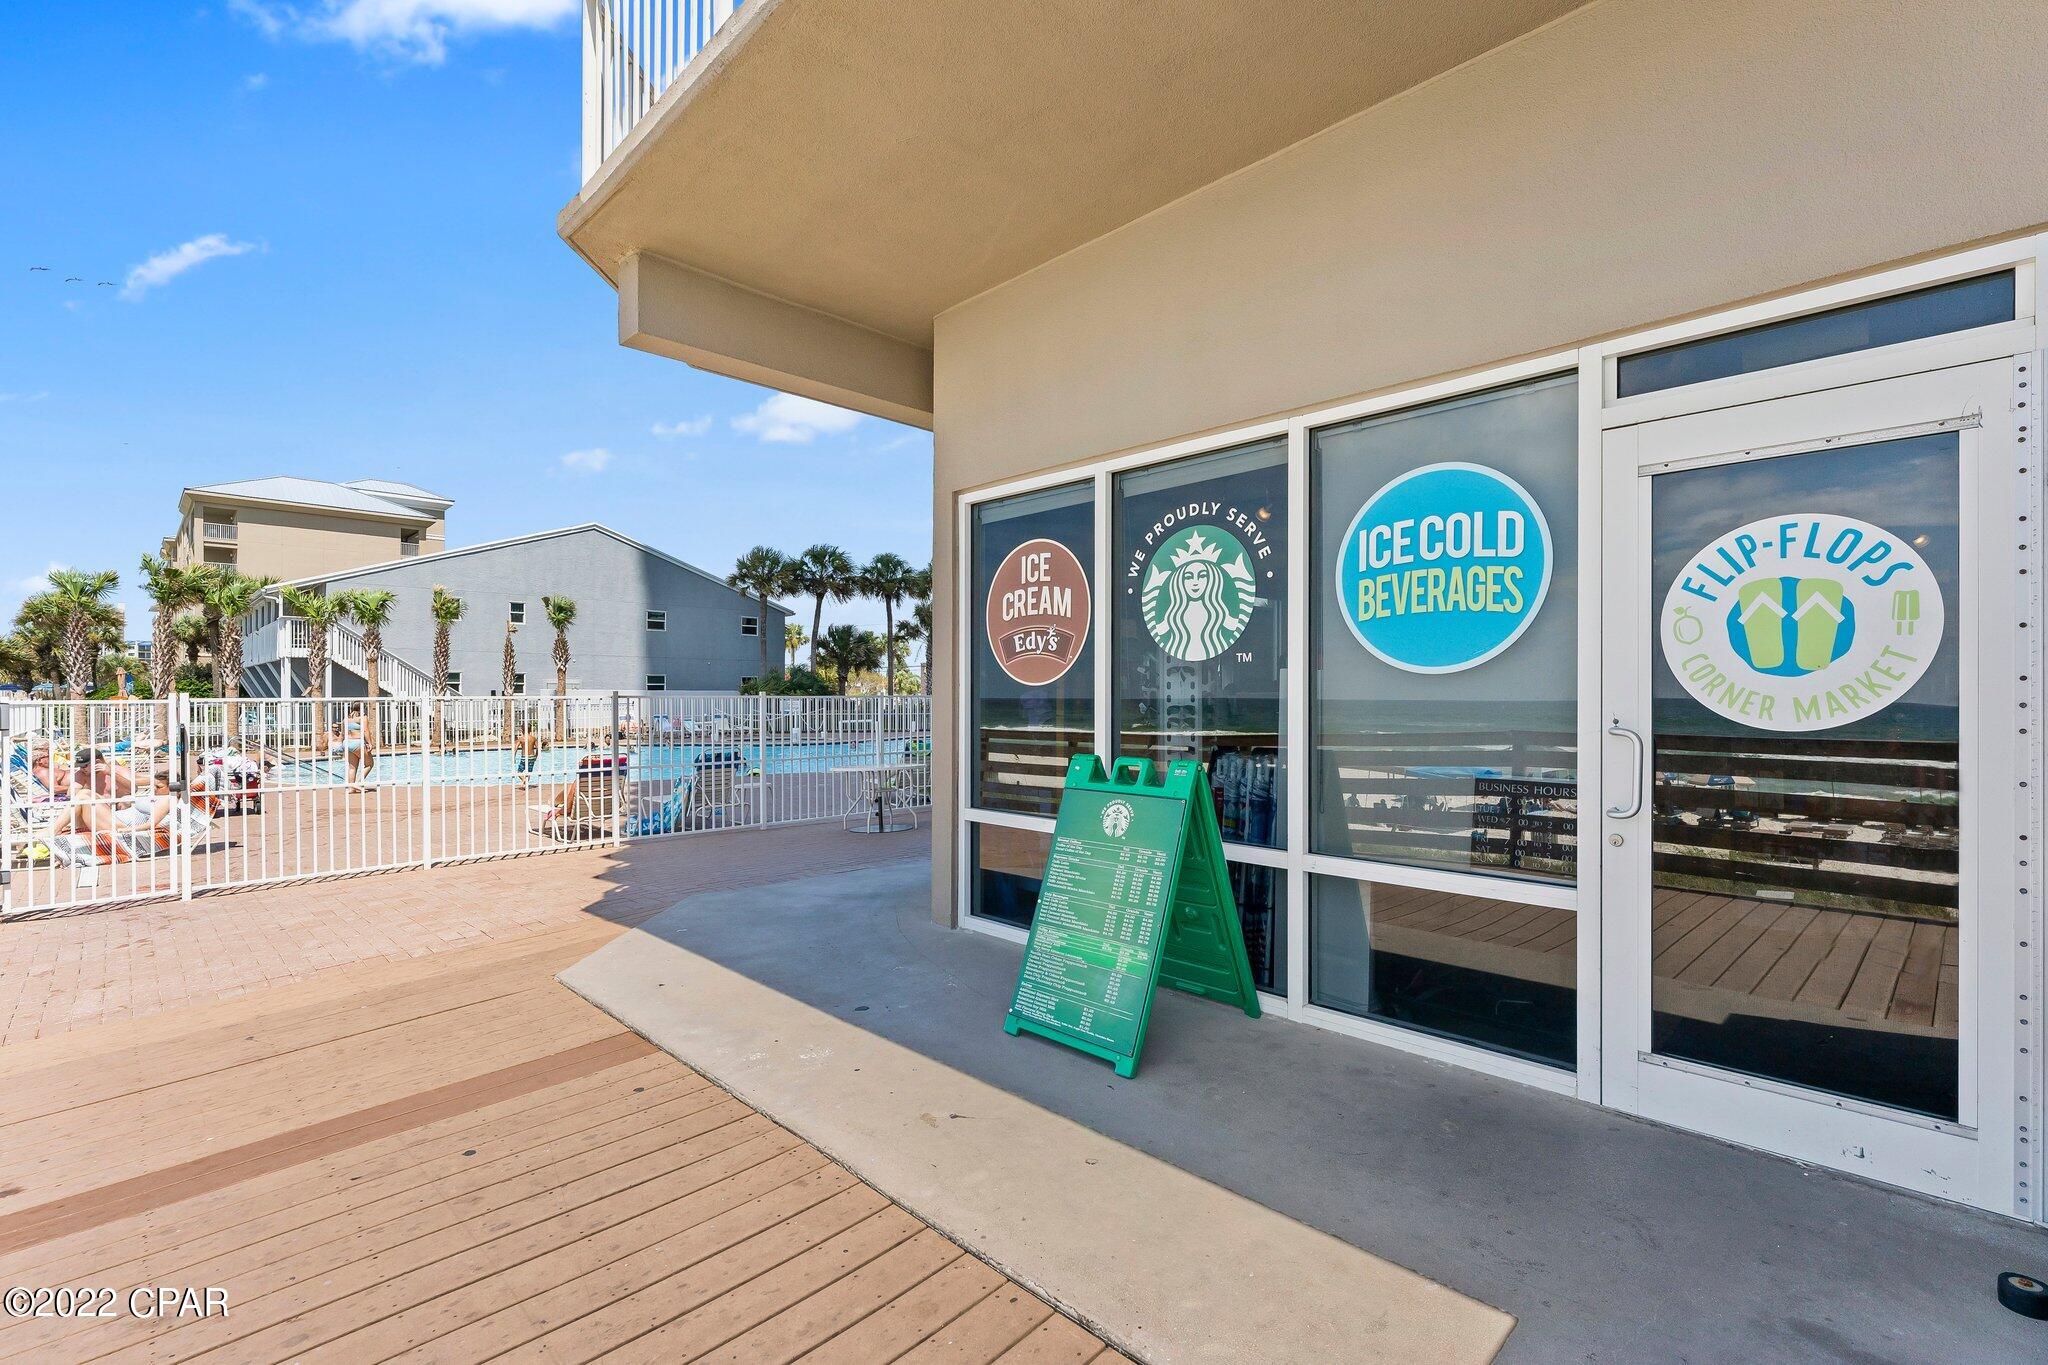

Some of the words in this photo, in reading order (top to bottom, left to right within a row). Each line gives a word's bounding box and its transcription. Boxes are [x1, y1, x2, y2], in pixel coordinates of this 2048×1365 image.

[1127, 549, 1147, 578] WE
[1144, 501, 1221, 546] PROUDLY
[1225, 506, 1272, 560] SERVE
[1358, 518, 1415, 573] ICE
[1419, 510, 1525, 561] COLD
[1681, 522, 1914, 602] FLIP-FLOPS
[1021, 552, 1052, 585] ICE
[1002, 586, 1072, 622] CREAM
[1358, 565, 1524, 622] BEVERAGES
[1013, 627, 1060, 655] Edy's
[1681, 653, 1775, 721] CORNER
[1792, 644, 1918, 723] MARKET
[1479, 782, 1529, 794] BUSINESS
[1534, 785, 1577, 798] HOURS
[1478, 815, 1499, 824] WED
